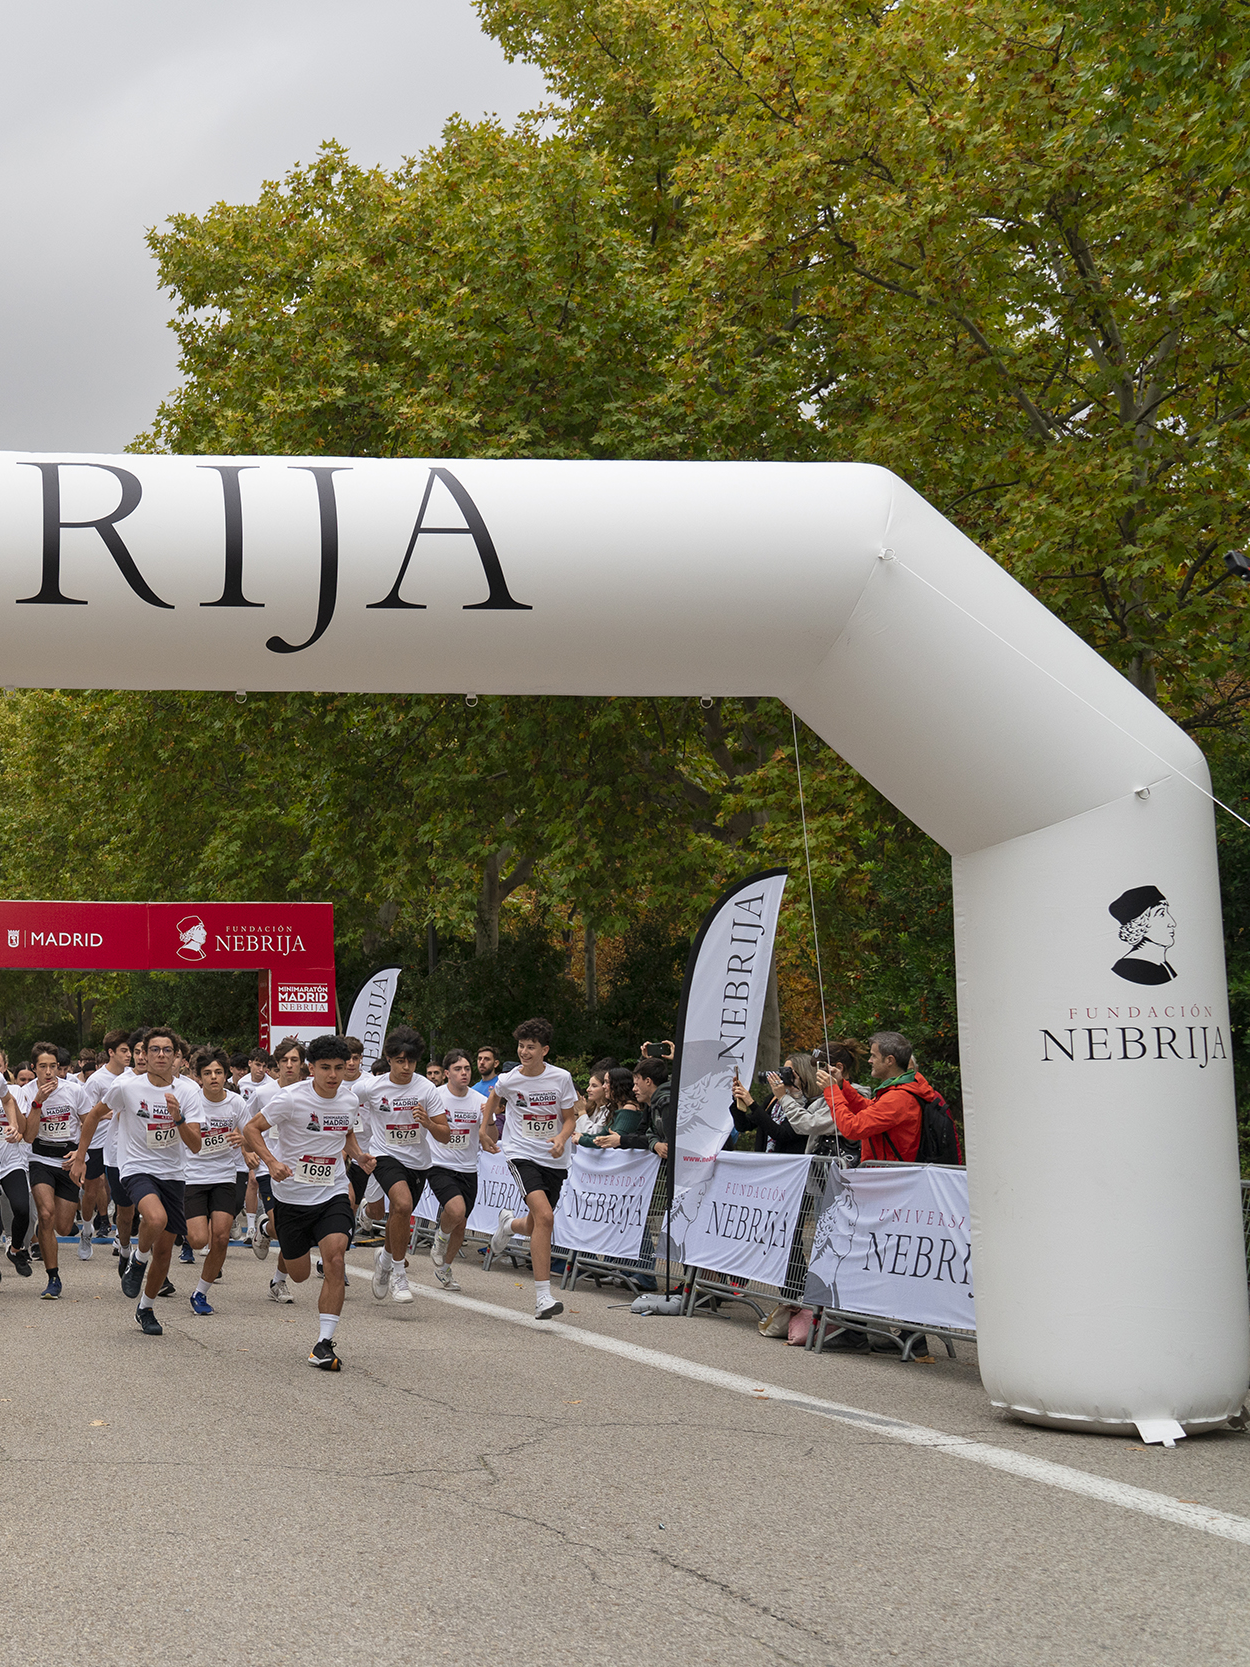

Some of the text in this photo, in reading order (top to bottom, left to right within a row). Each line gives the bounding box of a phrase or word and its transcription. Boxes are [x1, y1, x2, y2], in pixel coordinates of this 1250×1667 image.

[225, 924, 293, 932] FUNDACIÓN
[30, 931, 103, 947] MADRID
[215, 935, 306, 956] NEBRIJA
[718, 892, 765, 1062] NEBRIJA
[278, 992, 328, 1002] MADRID
[281, 1003, 327, 1012] NEBRIJA
[1068, 1004, 1213, 1020] FUNDACIÓN
[1038, 1026, 1228, 1069] NEBRIJA
[46, 1108, 70, 1116] MADRID
[42, 1122, 66, 1132] 1672
[526, 1121, 554, 1130] 1676
[155, 1129, 176, 1142] 670
[204, 1134, 224, 1146] 665
[389, 1130, 417, 1139] 1679
[450, 1135, 466, 1143] 681
[302, 1164, 332, 1177] 1698
[478, 1180, 528, 1218] NEBRIJ
[725, 1182, 787, 1202] FUNDACIÓN
[566, 1188, 642, 1234] NEBRIJA
[878, 1208, 966, 1230] UNIVERSI
[705, 1201, 788, 1256] NEBRIJA
[862, 1232, 974, 1299] NEBRI
